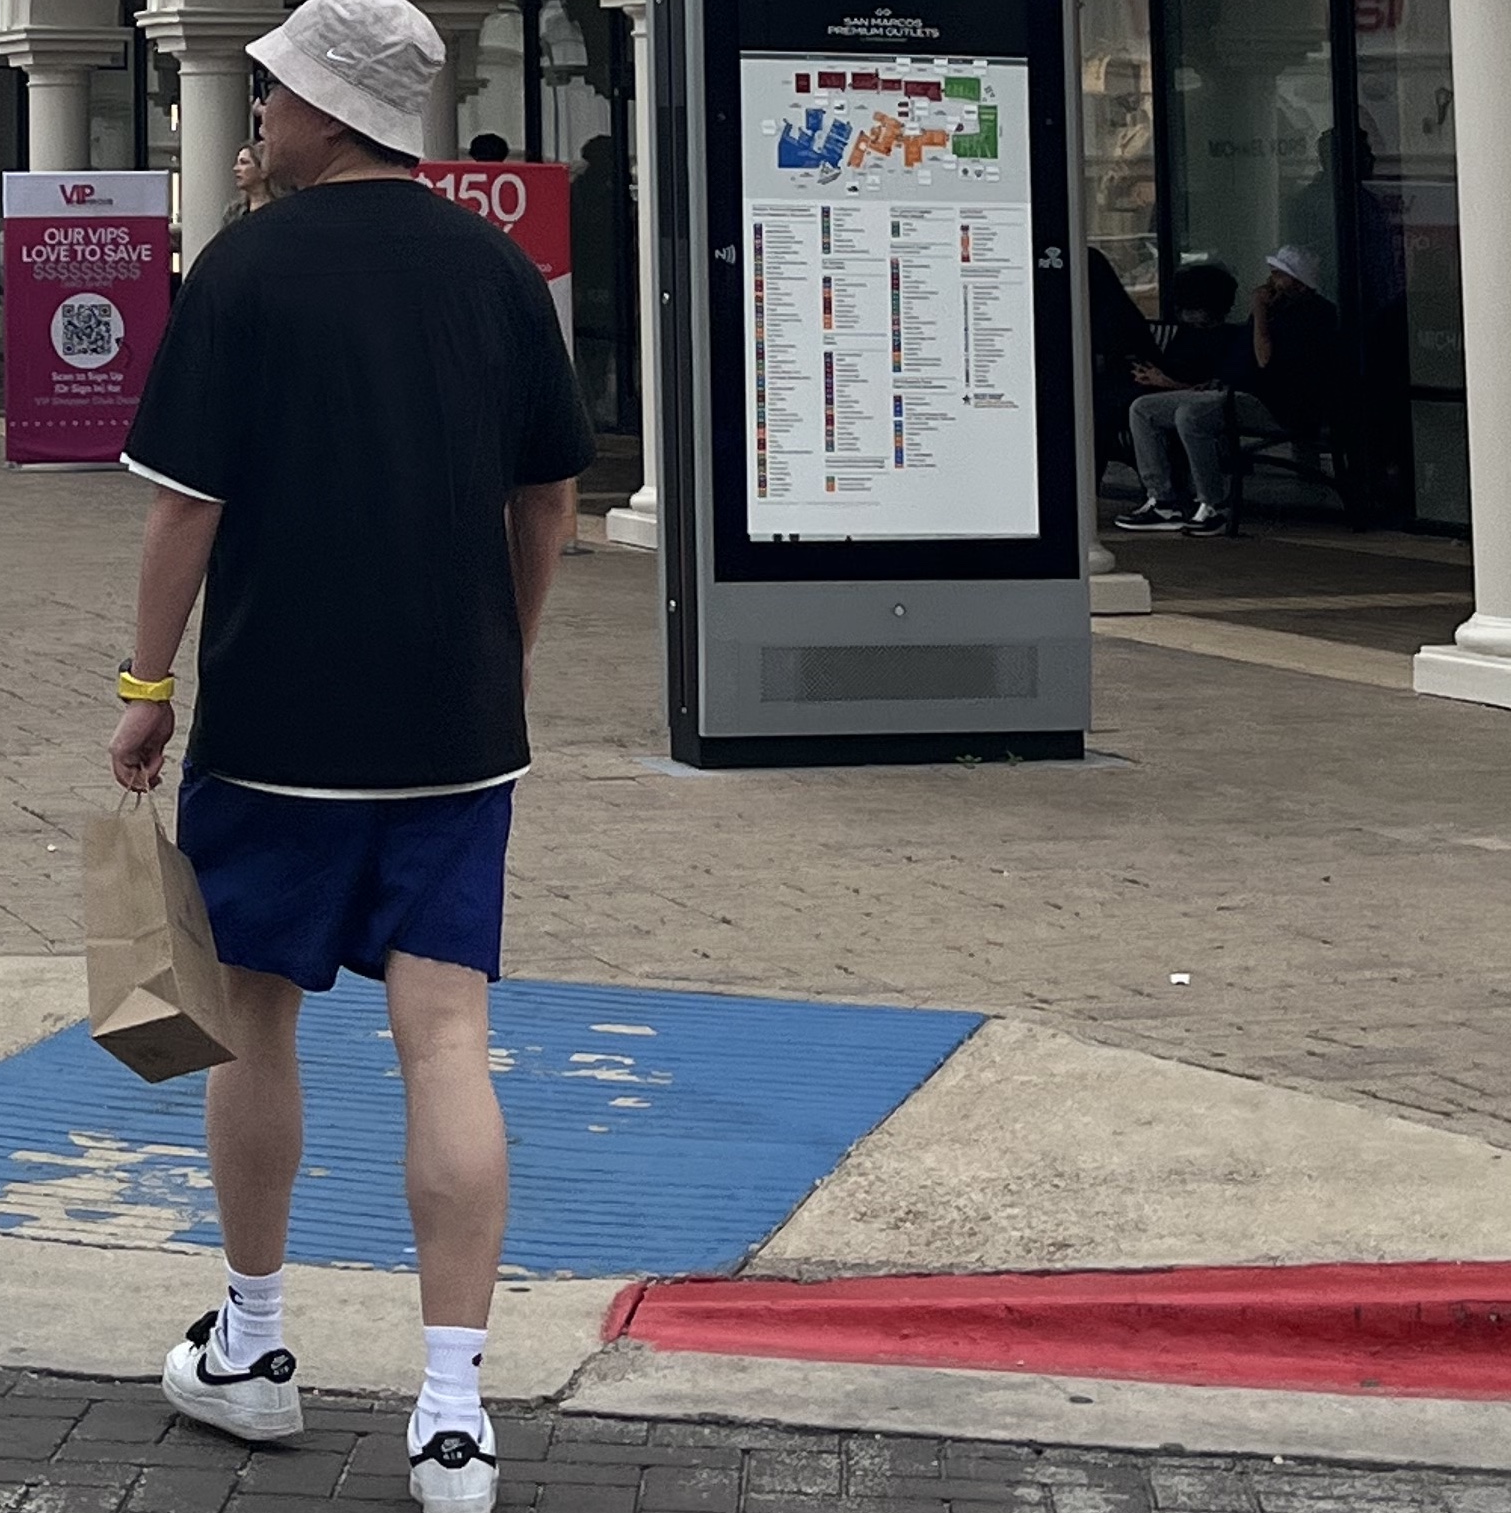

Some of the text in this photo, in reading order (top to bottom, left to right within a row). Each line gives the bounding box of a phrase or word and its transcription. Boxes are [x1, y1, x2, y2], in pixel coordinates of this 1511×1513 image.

[843, 17, 923, 28] SAN MARCOS
[828, 26, 940, 38] PREMIUM OUTLETS
[59, 184, 95, 205] VIP
[44, 227, 130, 244] OUR VIPS
[22, 244, 152, 262] LOVE TO SAVE
